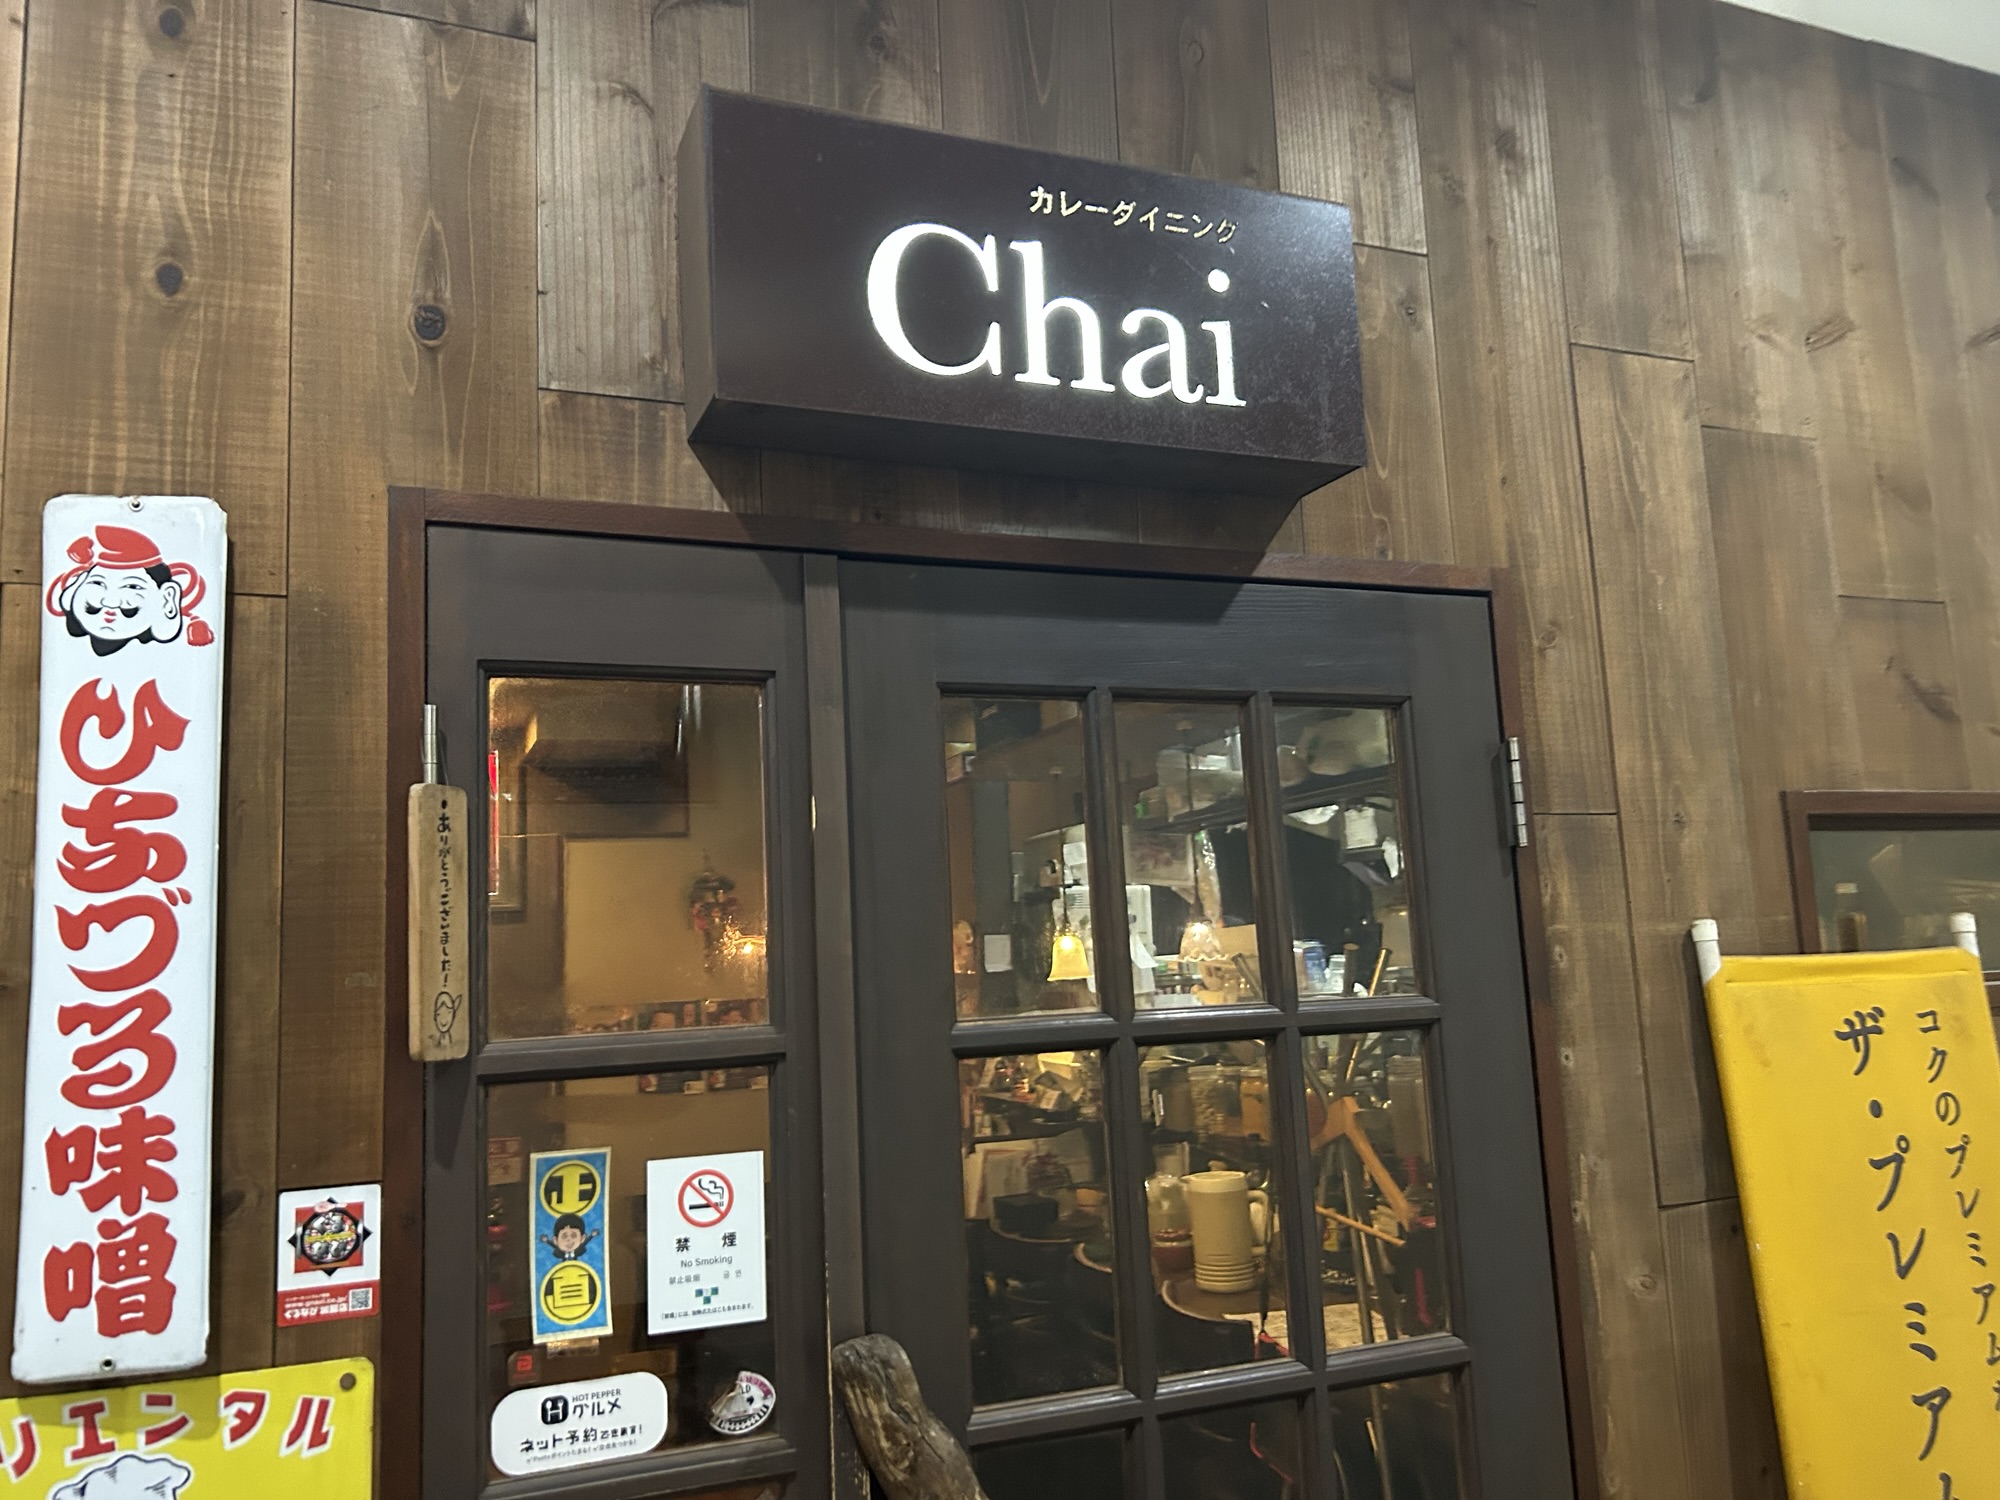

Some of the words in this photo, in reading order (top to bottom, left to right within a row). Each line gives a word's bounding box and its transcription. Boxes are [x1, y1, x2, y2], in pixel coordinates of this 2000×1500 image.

[1029, 185, 1240, 244] カレーダイニング
[867, 222, 1248, 408] Chai
[675, 1231, 737, 1253] 禁煙
[680, 1258, 693, 1268] No
[695, 1255, 733, 1267] Smoking
[572, 1393, 589, 1403] HOT
[591, 1388, 622, 1400] PEPPER
[572, 1398, 622, 1418] グルメ
[520, 1424, 643, 1453] ネット予約できます！
